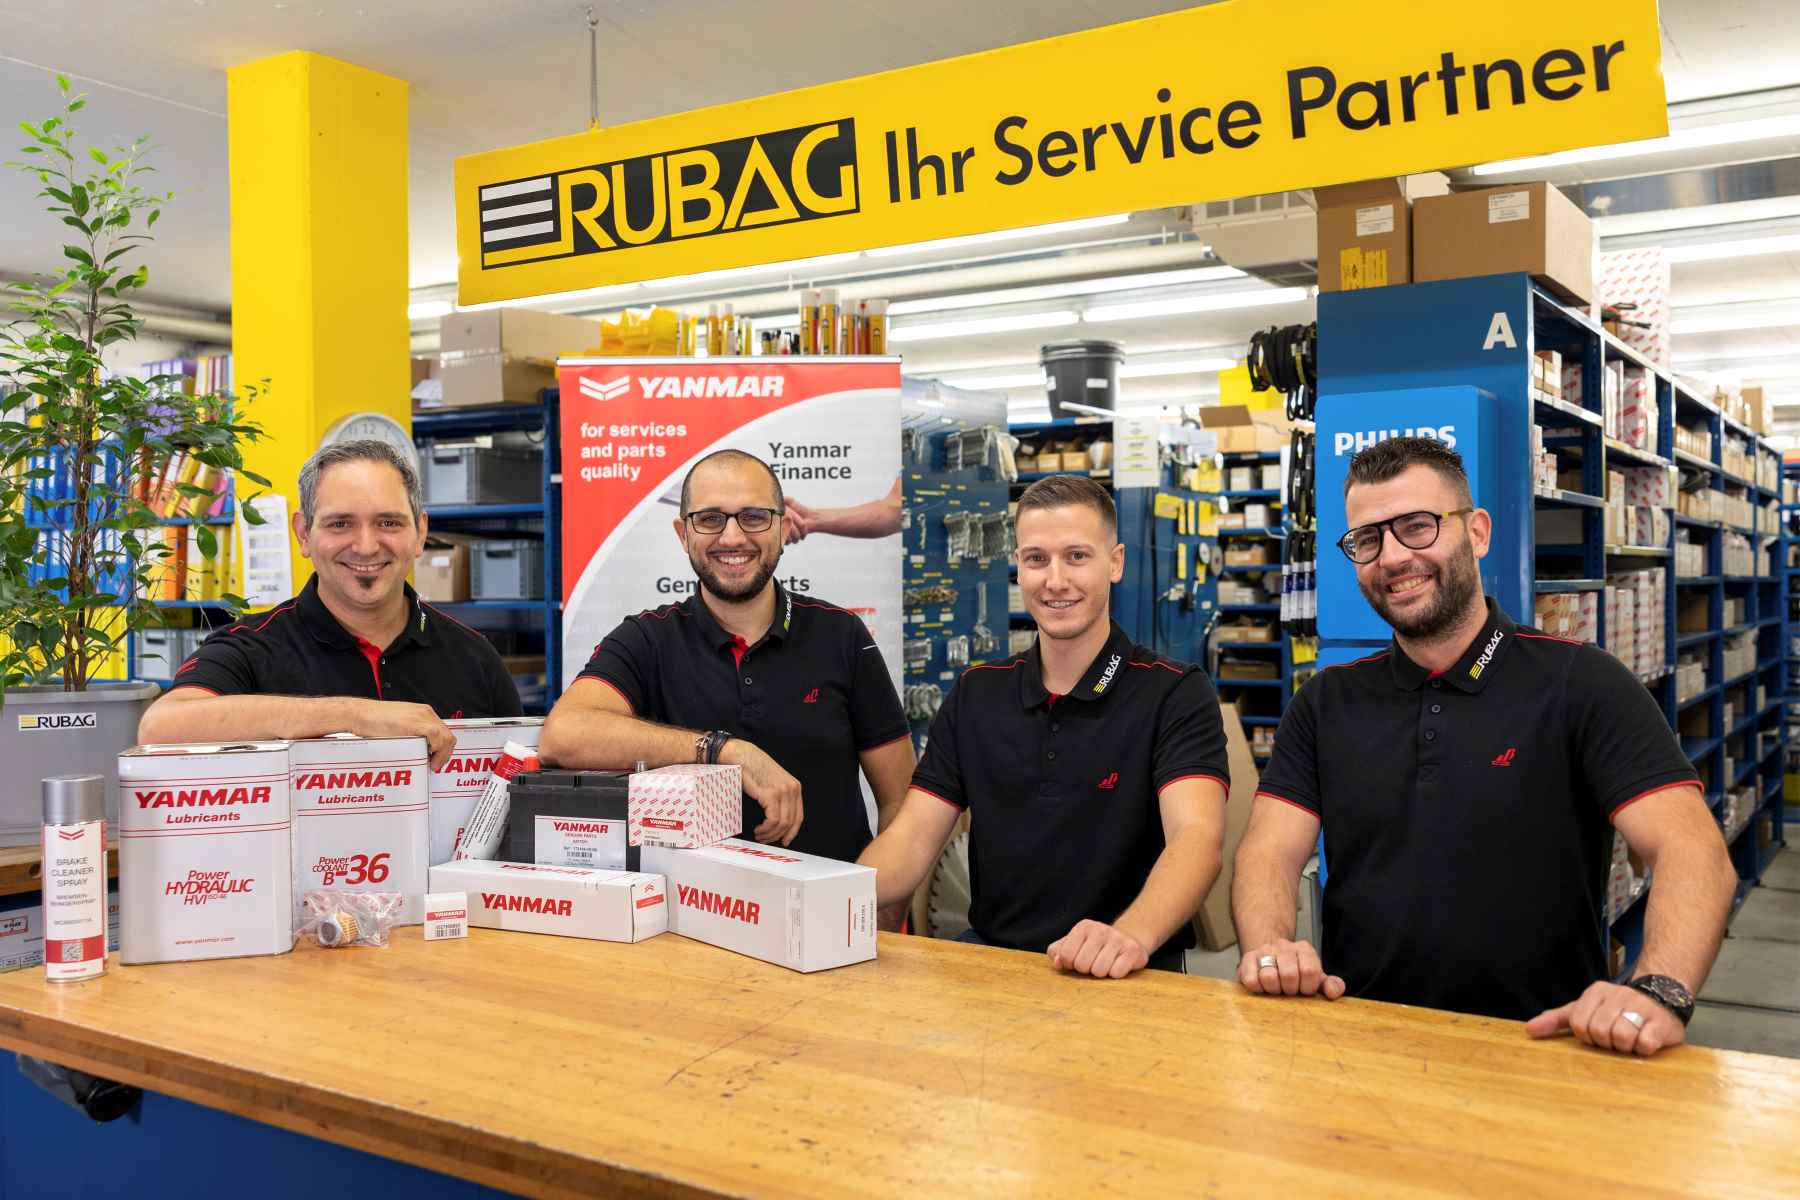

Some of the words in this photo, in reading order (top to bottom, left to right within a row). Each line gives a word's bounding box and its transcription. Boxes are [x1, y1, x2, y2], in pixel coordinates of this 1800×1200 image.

[884, 127, 975, 204] Ihr
[993, 88, 1262, 186] Service
[1286, 40, 1627, 140] Partner
[1482, 312, 1517, 350] A
[638, 375, 785, 399] YANMAR
[581, 422, 605, 438] for
[609, 422, 687, 437] services
[581, 443, 610, 458] and
[618, 443, 666, 461] parts
[768, 442, 852, 459] Yanmar
[580, 463, 641, 482] quality
[1474, 629, 1504, 671] RUBAG
[1097, 654, 1121, 689] RUBAG
[36, 714, 96, 729] RUBAG
[296, 770, 411, 790] YANMAR
[135, 786, 271, 808] YANMAR
[318, 793, 385, 805] Lubricants
[166, 812, 240, 825] Lubricants
[649, 819, 677, 827] YANMAR
[553, 821, 608, 833] YANMAR
[56, 856, 89, 867] BRAKE
[312, 864, 350, 873] COOLANT
[319, 856, 350, 865] Power
[51, 867, 95, 877] CLEANER
[188, 870, 229, 881] Power
[56, 878, 88, 888] SPRAY
[165, 879, 254, 895] HYDRAULIC
[184, 894, 207, 906] HVI
[481, 892, 574, 917] YANMAR
[677, 884, 760, 925] YANMAR
